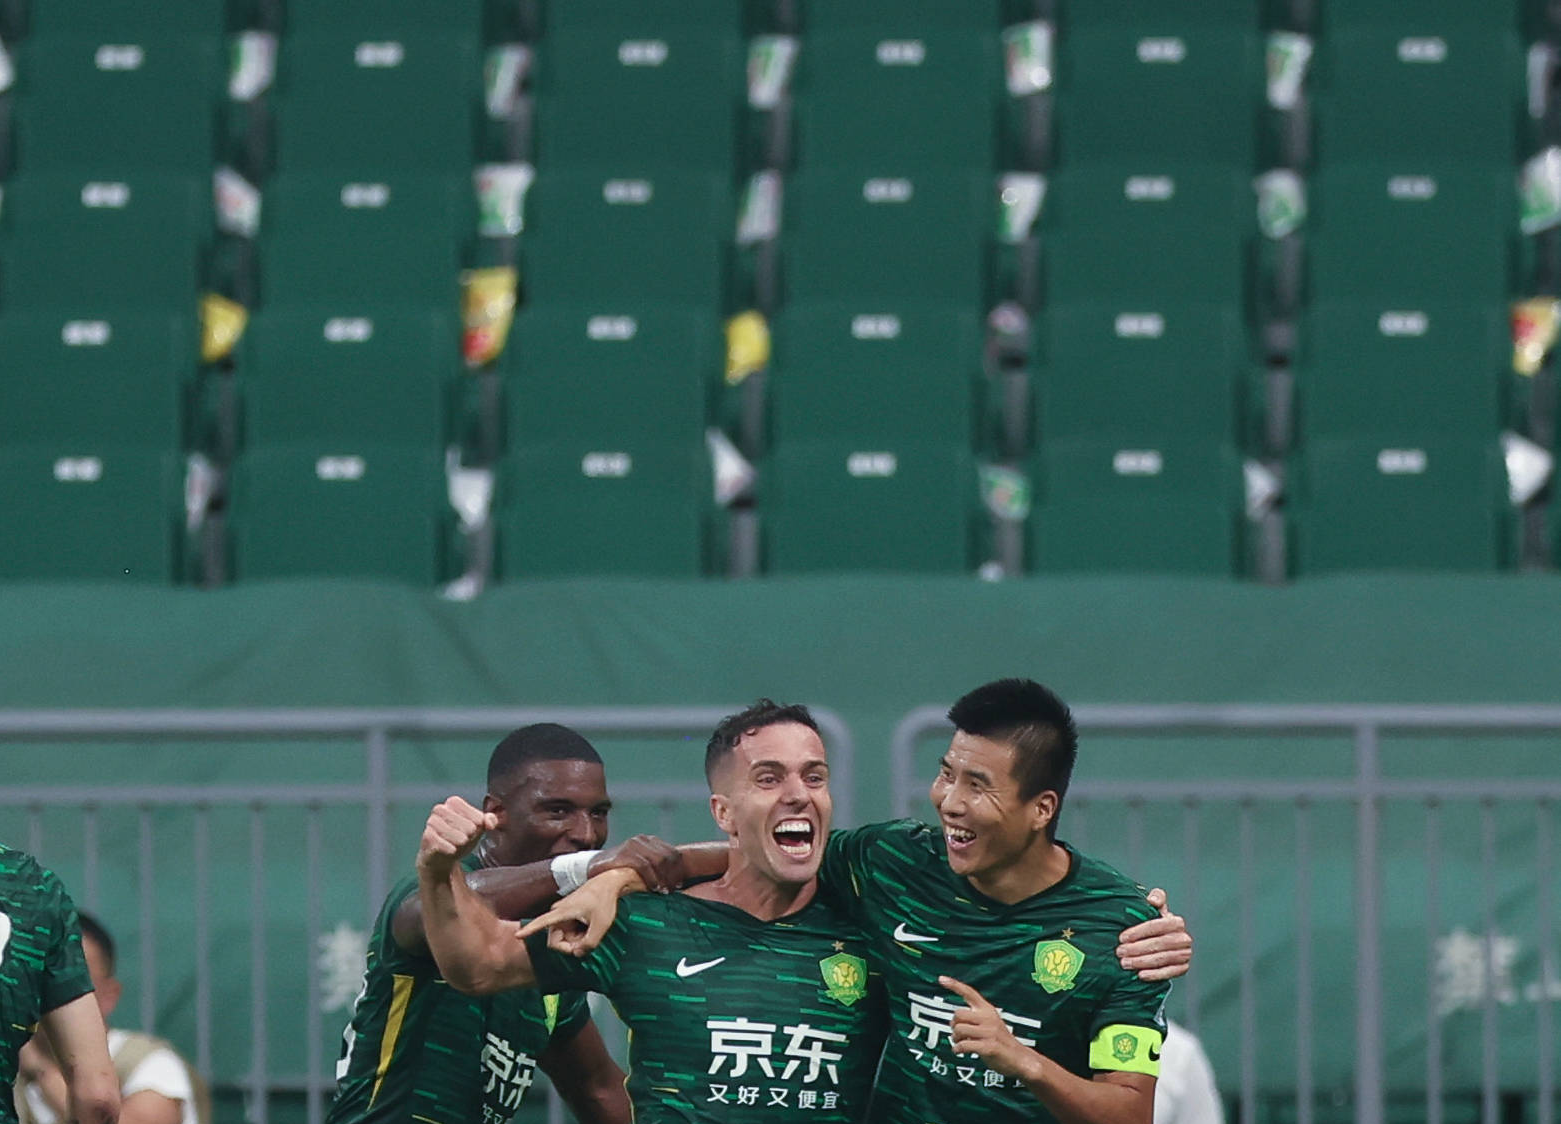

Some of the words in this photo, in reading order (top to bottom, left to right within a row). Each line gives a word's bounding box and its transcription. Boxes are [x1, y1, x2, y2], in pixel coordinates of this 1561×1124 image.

[706, 1017, 849, 1085] 京东
[706, 1083, 840, 1111] 又好又便宜
